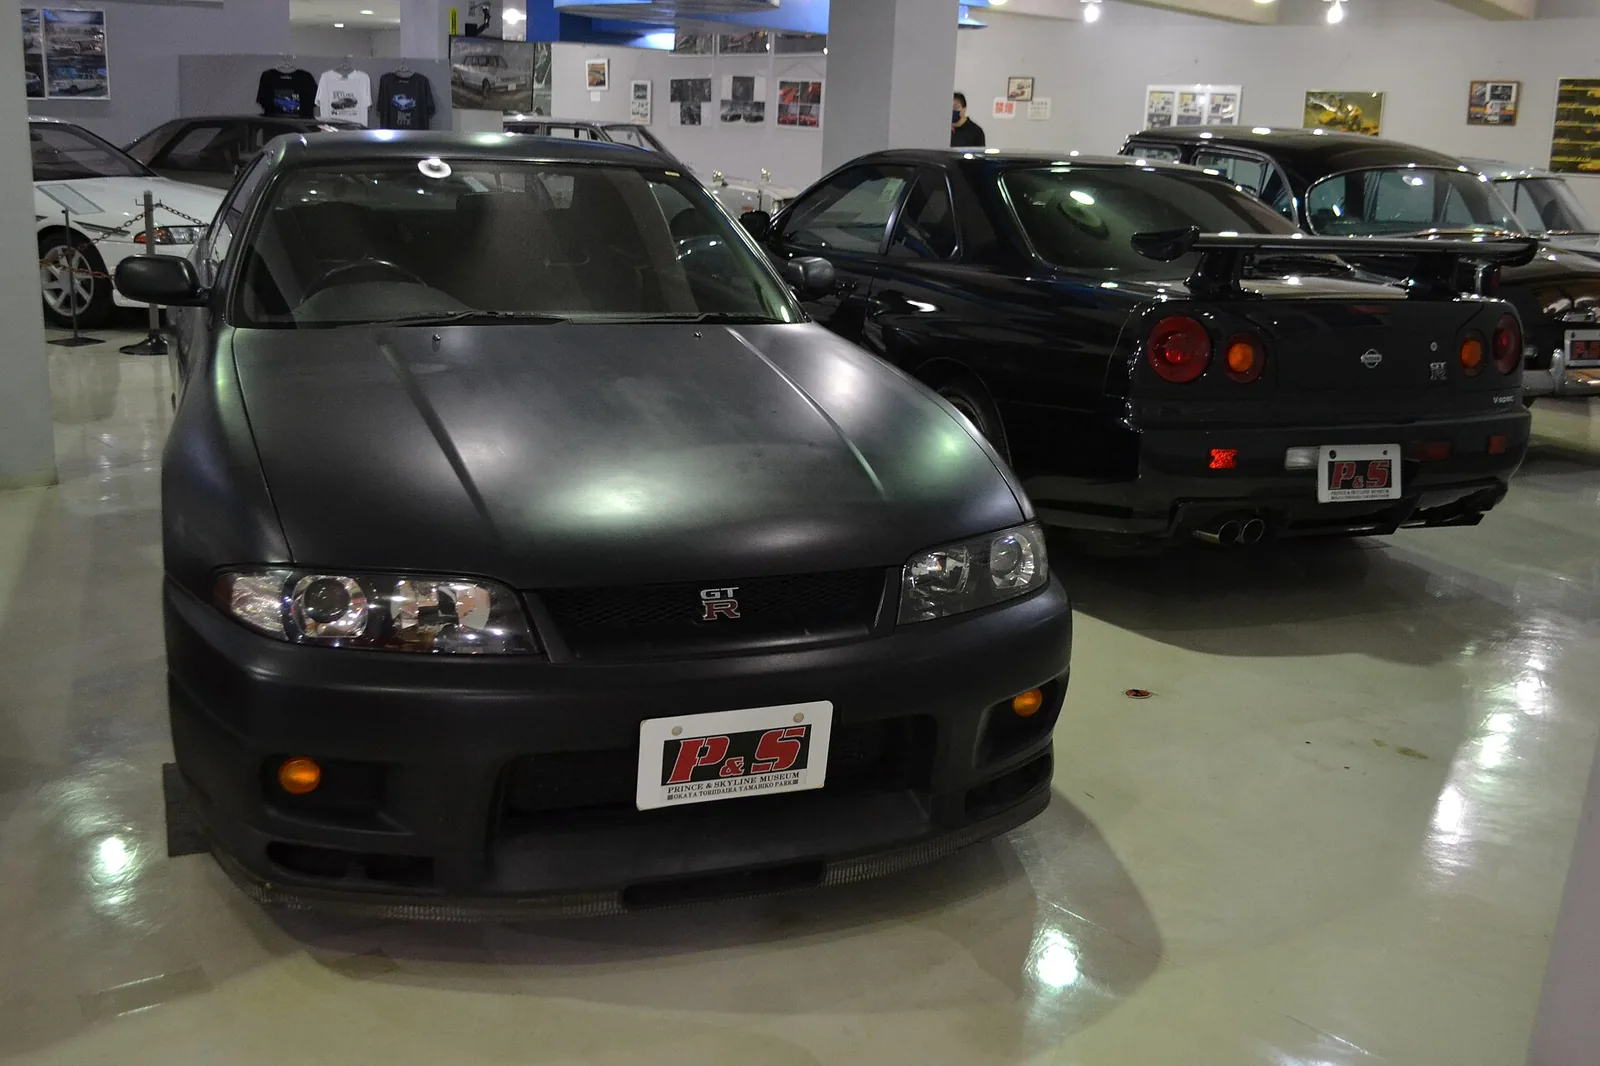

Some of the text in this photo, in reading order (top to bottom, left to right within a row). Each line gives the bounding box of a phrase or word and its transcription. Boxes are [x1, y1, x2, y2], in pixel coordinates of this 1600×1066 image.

[668, 783, 704, 793] PRINCE
[714, 776, 757, 787] SKYLINE
[759, 771, 800, 782] MUSEUM
[673, 791, 697, 799] OKAYA
[738, 782, 774, 792] YAMABIKO
[774, 779, 793, 788] PARK
